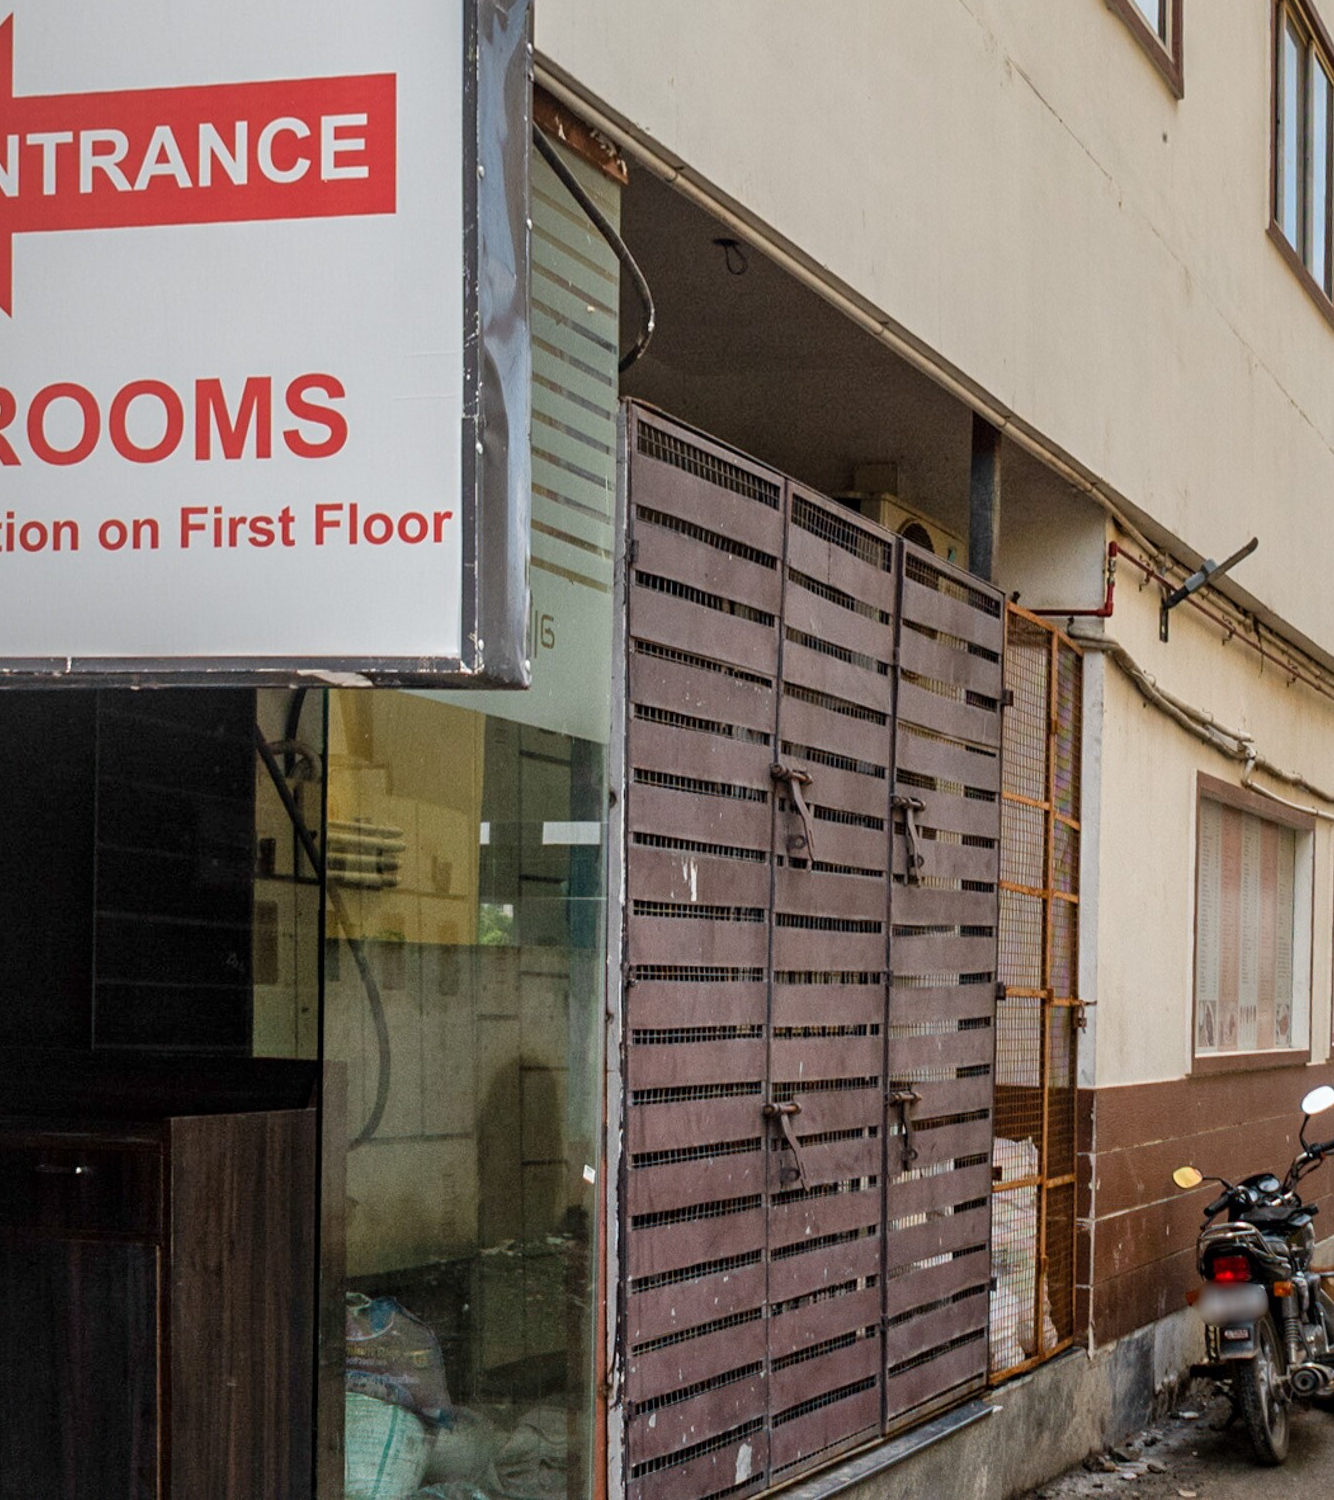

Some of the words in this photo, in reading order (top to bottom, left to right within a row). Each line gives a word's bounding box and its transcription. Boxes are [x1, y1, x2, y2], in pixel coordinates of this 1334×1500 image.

[98, 517, 160, 550] on
[180, 505, 295, 550] First
[315, 503, 453, 546] Floor
